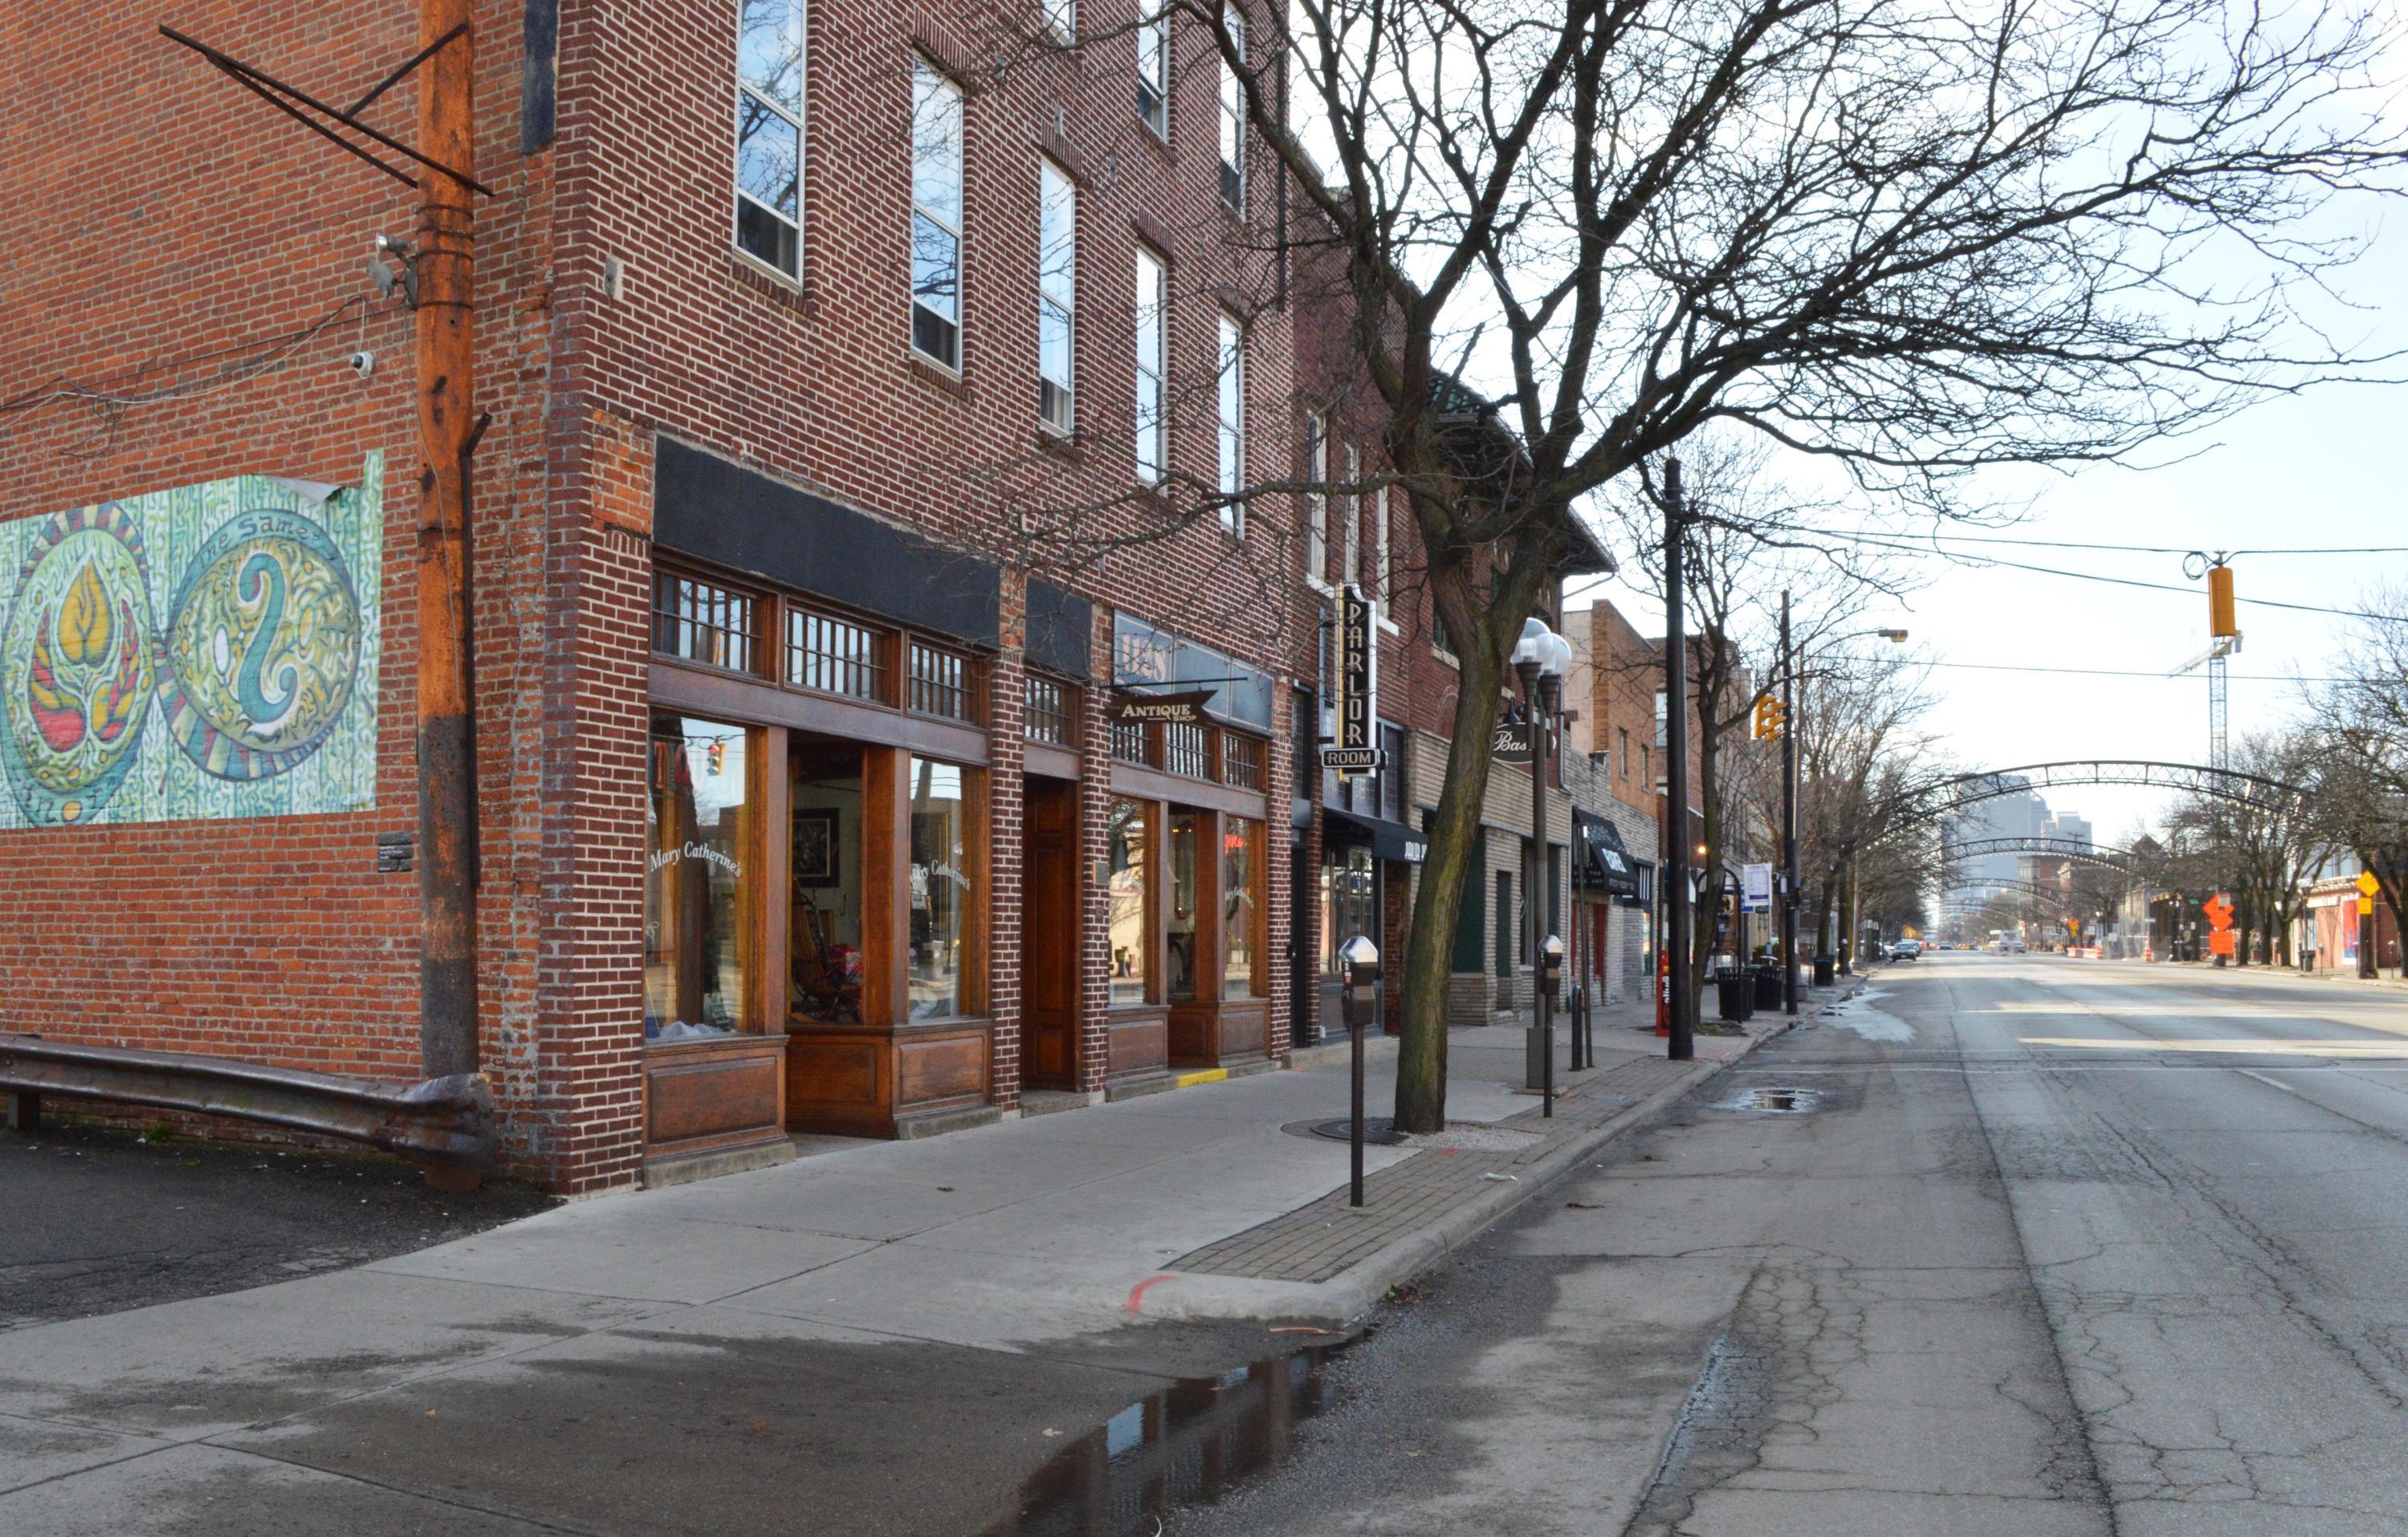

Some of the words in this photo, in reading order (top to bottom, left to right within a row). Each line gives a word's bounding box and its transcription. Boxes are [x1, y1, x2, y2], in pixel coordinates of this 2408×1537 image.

[1347, 602, 1363, 745] PARLOR
[1121, 704, 1191, 720] ANTIQUE
[1172, 714, 1197, 722] SHOP
[1493, 730, 1532, 752] Bas
[1326, 752, 1371, 764] ROOM
[650, 847, 681, 873] Mary
[684, 841, 743, 879] Catherine's
